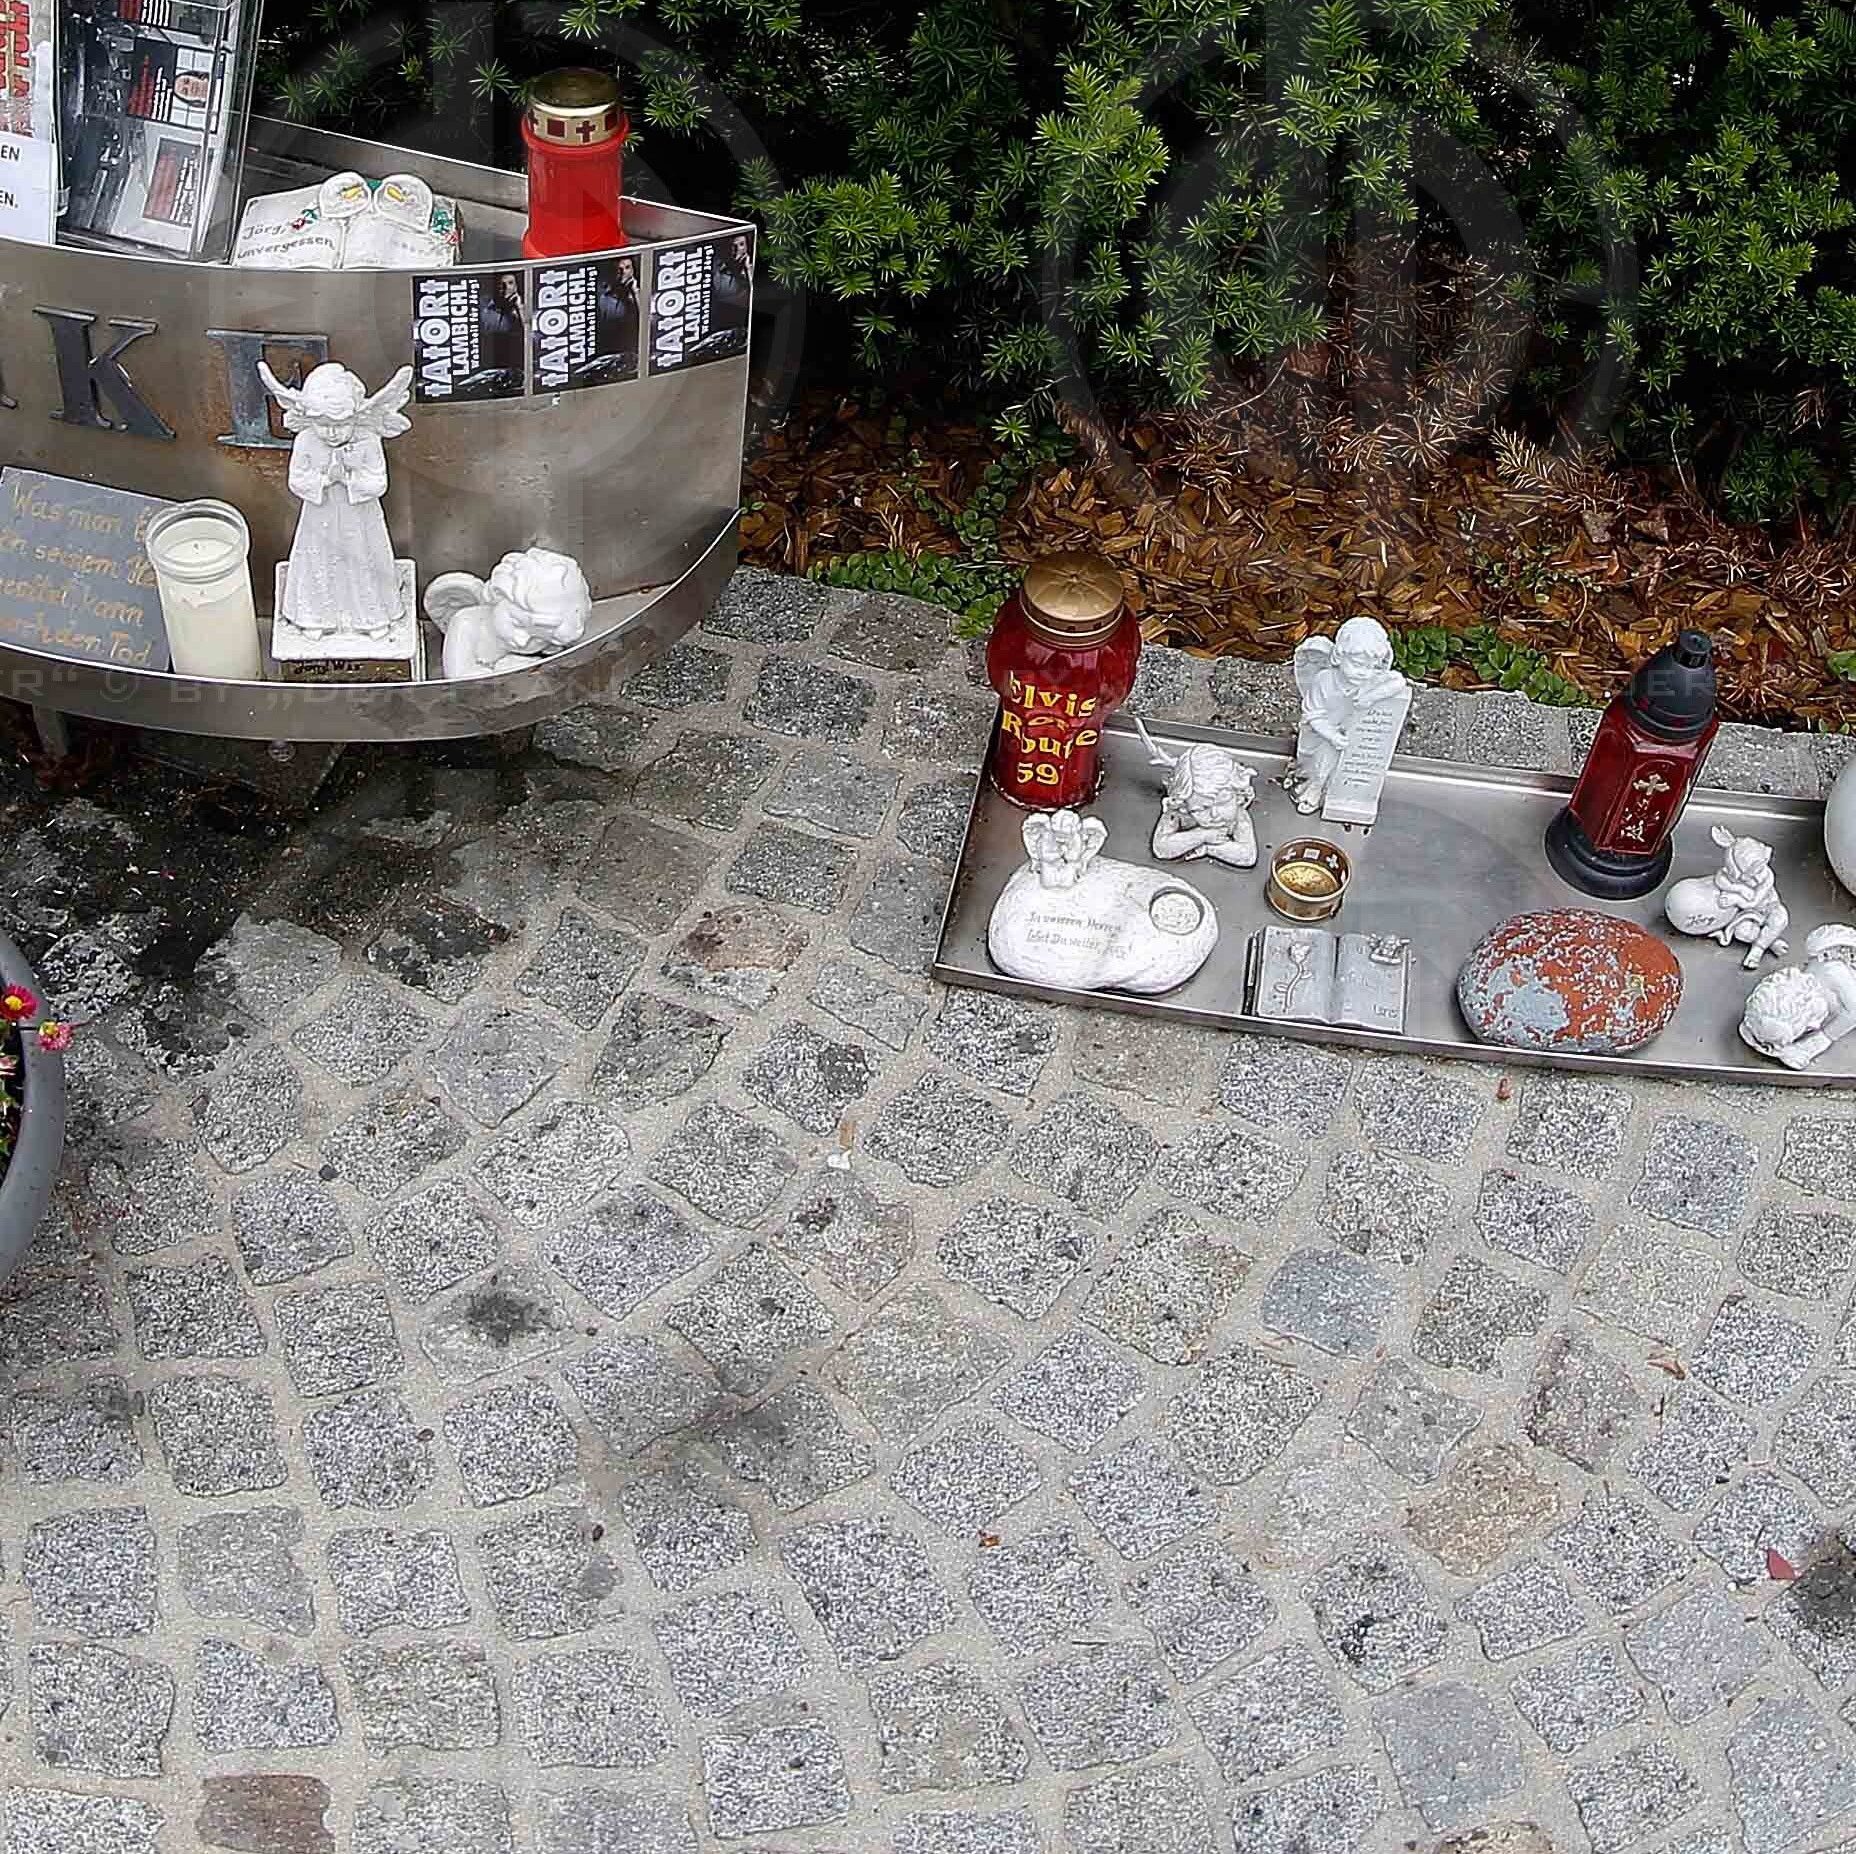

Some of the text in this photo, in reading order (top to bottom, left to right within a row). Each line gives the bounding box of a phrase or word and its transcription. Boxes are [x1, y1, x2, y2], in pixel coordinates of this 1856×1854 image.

[10, 0, 33, 68] ruht
[241, 224, 287, 241] Jörg,
[587, 296, 597, 313] für
[685, 245, 704, 344] LAMBICHL
[703, 277, 713, 294] für
[450, 278, 470, 376] LAMBICHL
[471, 309, 481, 327] für
[568, 266, 587, 365] LAMBICHL
[703, 293, 713, 333] Wahrheit
[471, 326, 481, 369] Wahrheit
[587, 312, 597, 357] Wahrheit
[108, 629, 153, 665] Tod
[1009, 669, 1098, 717] Elvis
[1016, 762, 1060, 786] 59
